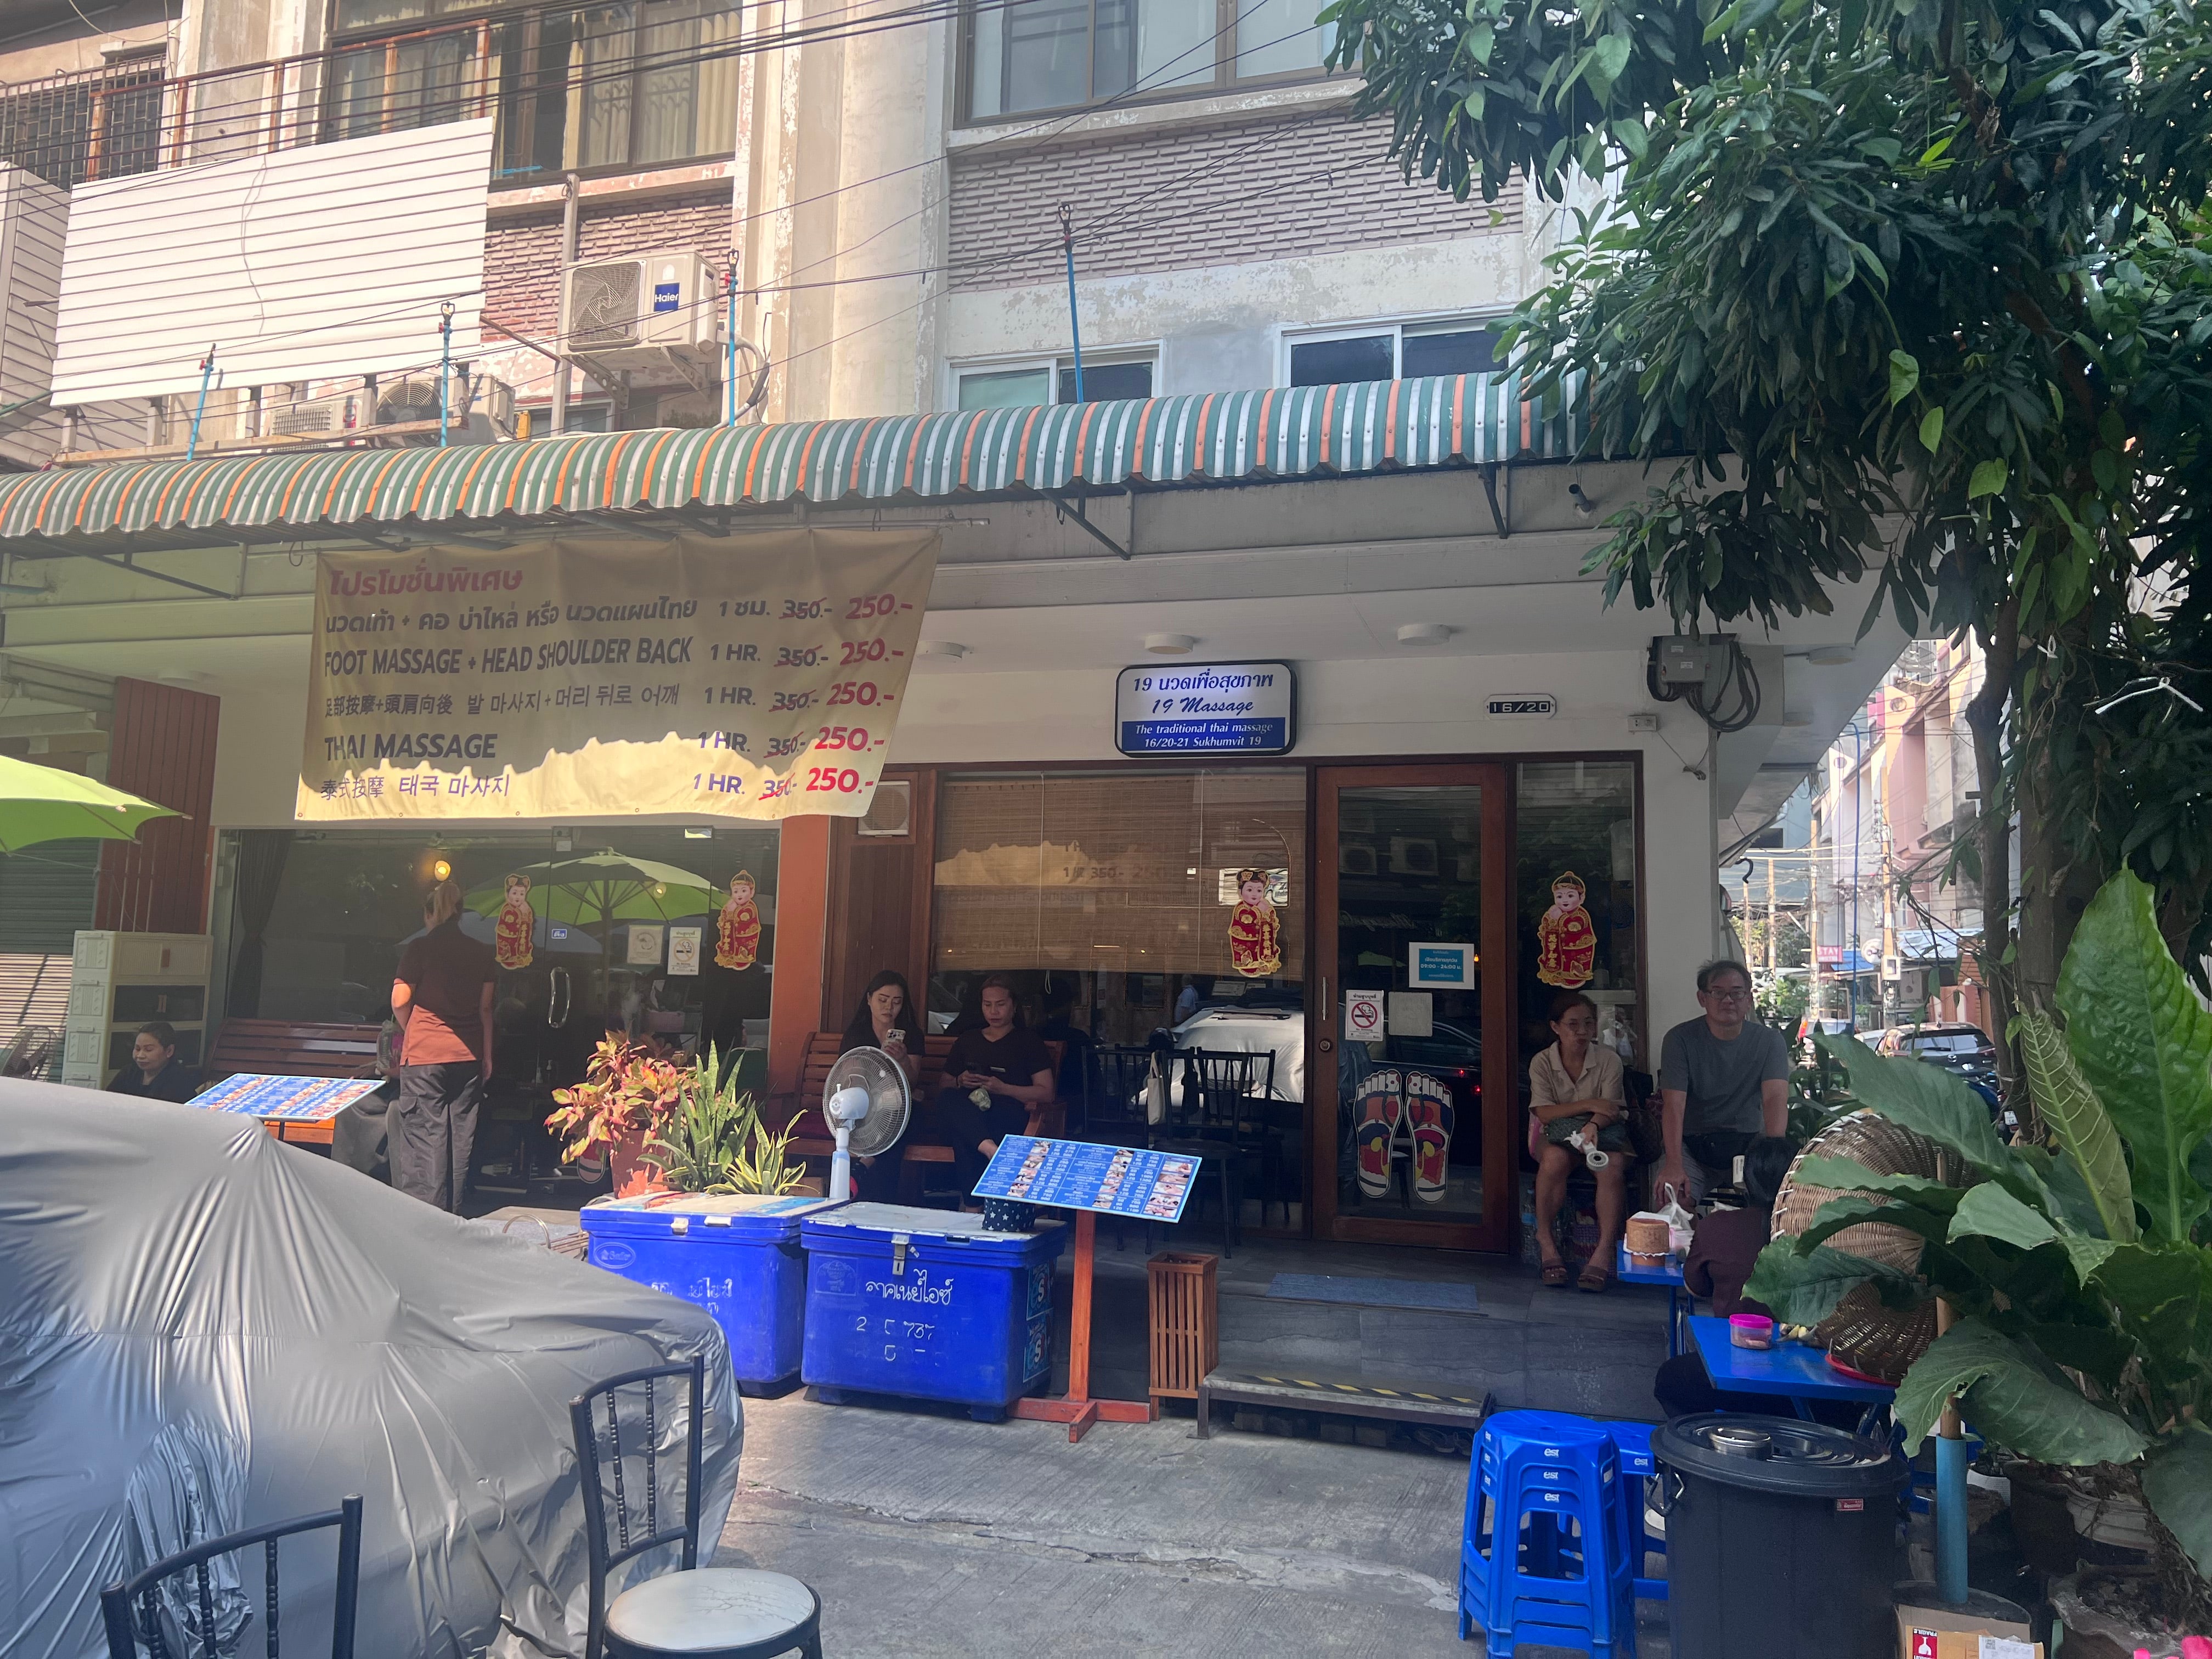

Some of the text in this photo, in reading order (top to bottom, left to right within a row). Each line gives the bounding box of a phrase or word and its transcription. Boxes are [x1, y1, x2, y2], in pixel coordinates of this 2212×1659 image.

[654, 294, 679, 303] Haier
[330, 558, 523, 596] โปรโมชั่นพิเศษ
[326, 608, 394, 633] นวดเท้า
[402, 615, 410, 625] +
[419, 612, 449, 630] คอ
[459, 601, 518, 630] บ่าไหล่
[526, 600, 559, 627] หรือ
[566, 596, 697, 622] นวดแผนไทย
[719, 602, 727, 616] 1
[735, 600, 770, 616] ชม.
[845, 593, 913, 619] 250.-
[325, 649, 367, 677] FOOT
[372, 648, 463, 674] MASSAGE
[468, 657, 476, 669] +
[482, 646, 533, 673] HEAD
[537, 637, 631, 670] SHOULDER
[636, 636, 694, 664] BACK
[710, 644, 719, 660] 1
[726, 644, 760, 661] HR.
[839, 638, 904, 666] 250.-
[1134, 668, 1274, 693] 19 นวดเพื่อสุขภาพ
[467, 694, 484, 714] 발
[595, 684, 632, 706] 뒤로
[641, 683, 680, 706] 어깨
[705, 687, 713, 703] 1
[720, 686, 756, 706] HR.
[826, 681, 895, 707] 250.-
[1152, 697, 1254, 716] 19 Massage
[1493, 703, 1549, 712] 16/20
[1136, 723, 1273, 734] The traditional thai massage
[1145, 736, 1261, 748] 16/20-21 Sukhumvit 19
[324, 734, 366, 760] THAI
[374, 733, 498, 758] MASSAGE
[698, 732, 707, 748] 1
[714, 731, 751, 752] HR.
[814, 726, 884, 752] 250.-
[320, 775, 384, 800] 泰式按摩
[399, 774, 440, 795] 태국
[448, 774, 510, 797] 마사지
[693, 774, 701, 789] 1
[708, 774, 745, 794] HR.
[806, 768, 874, 794] 250.-
